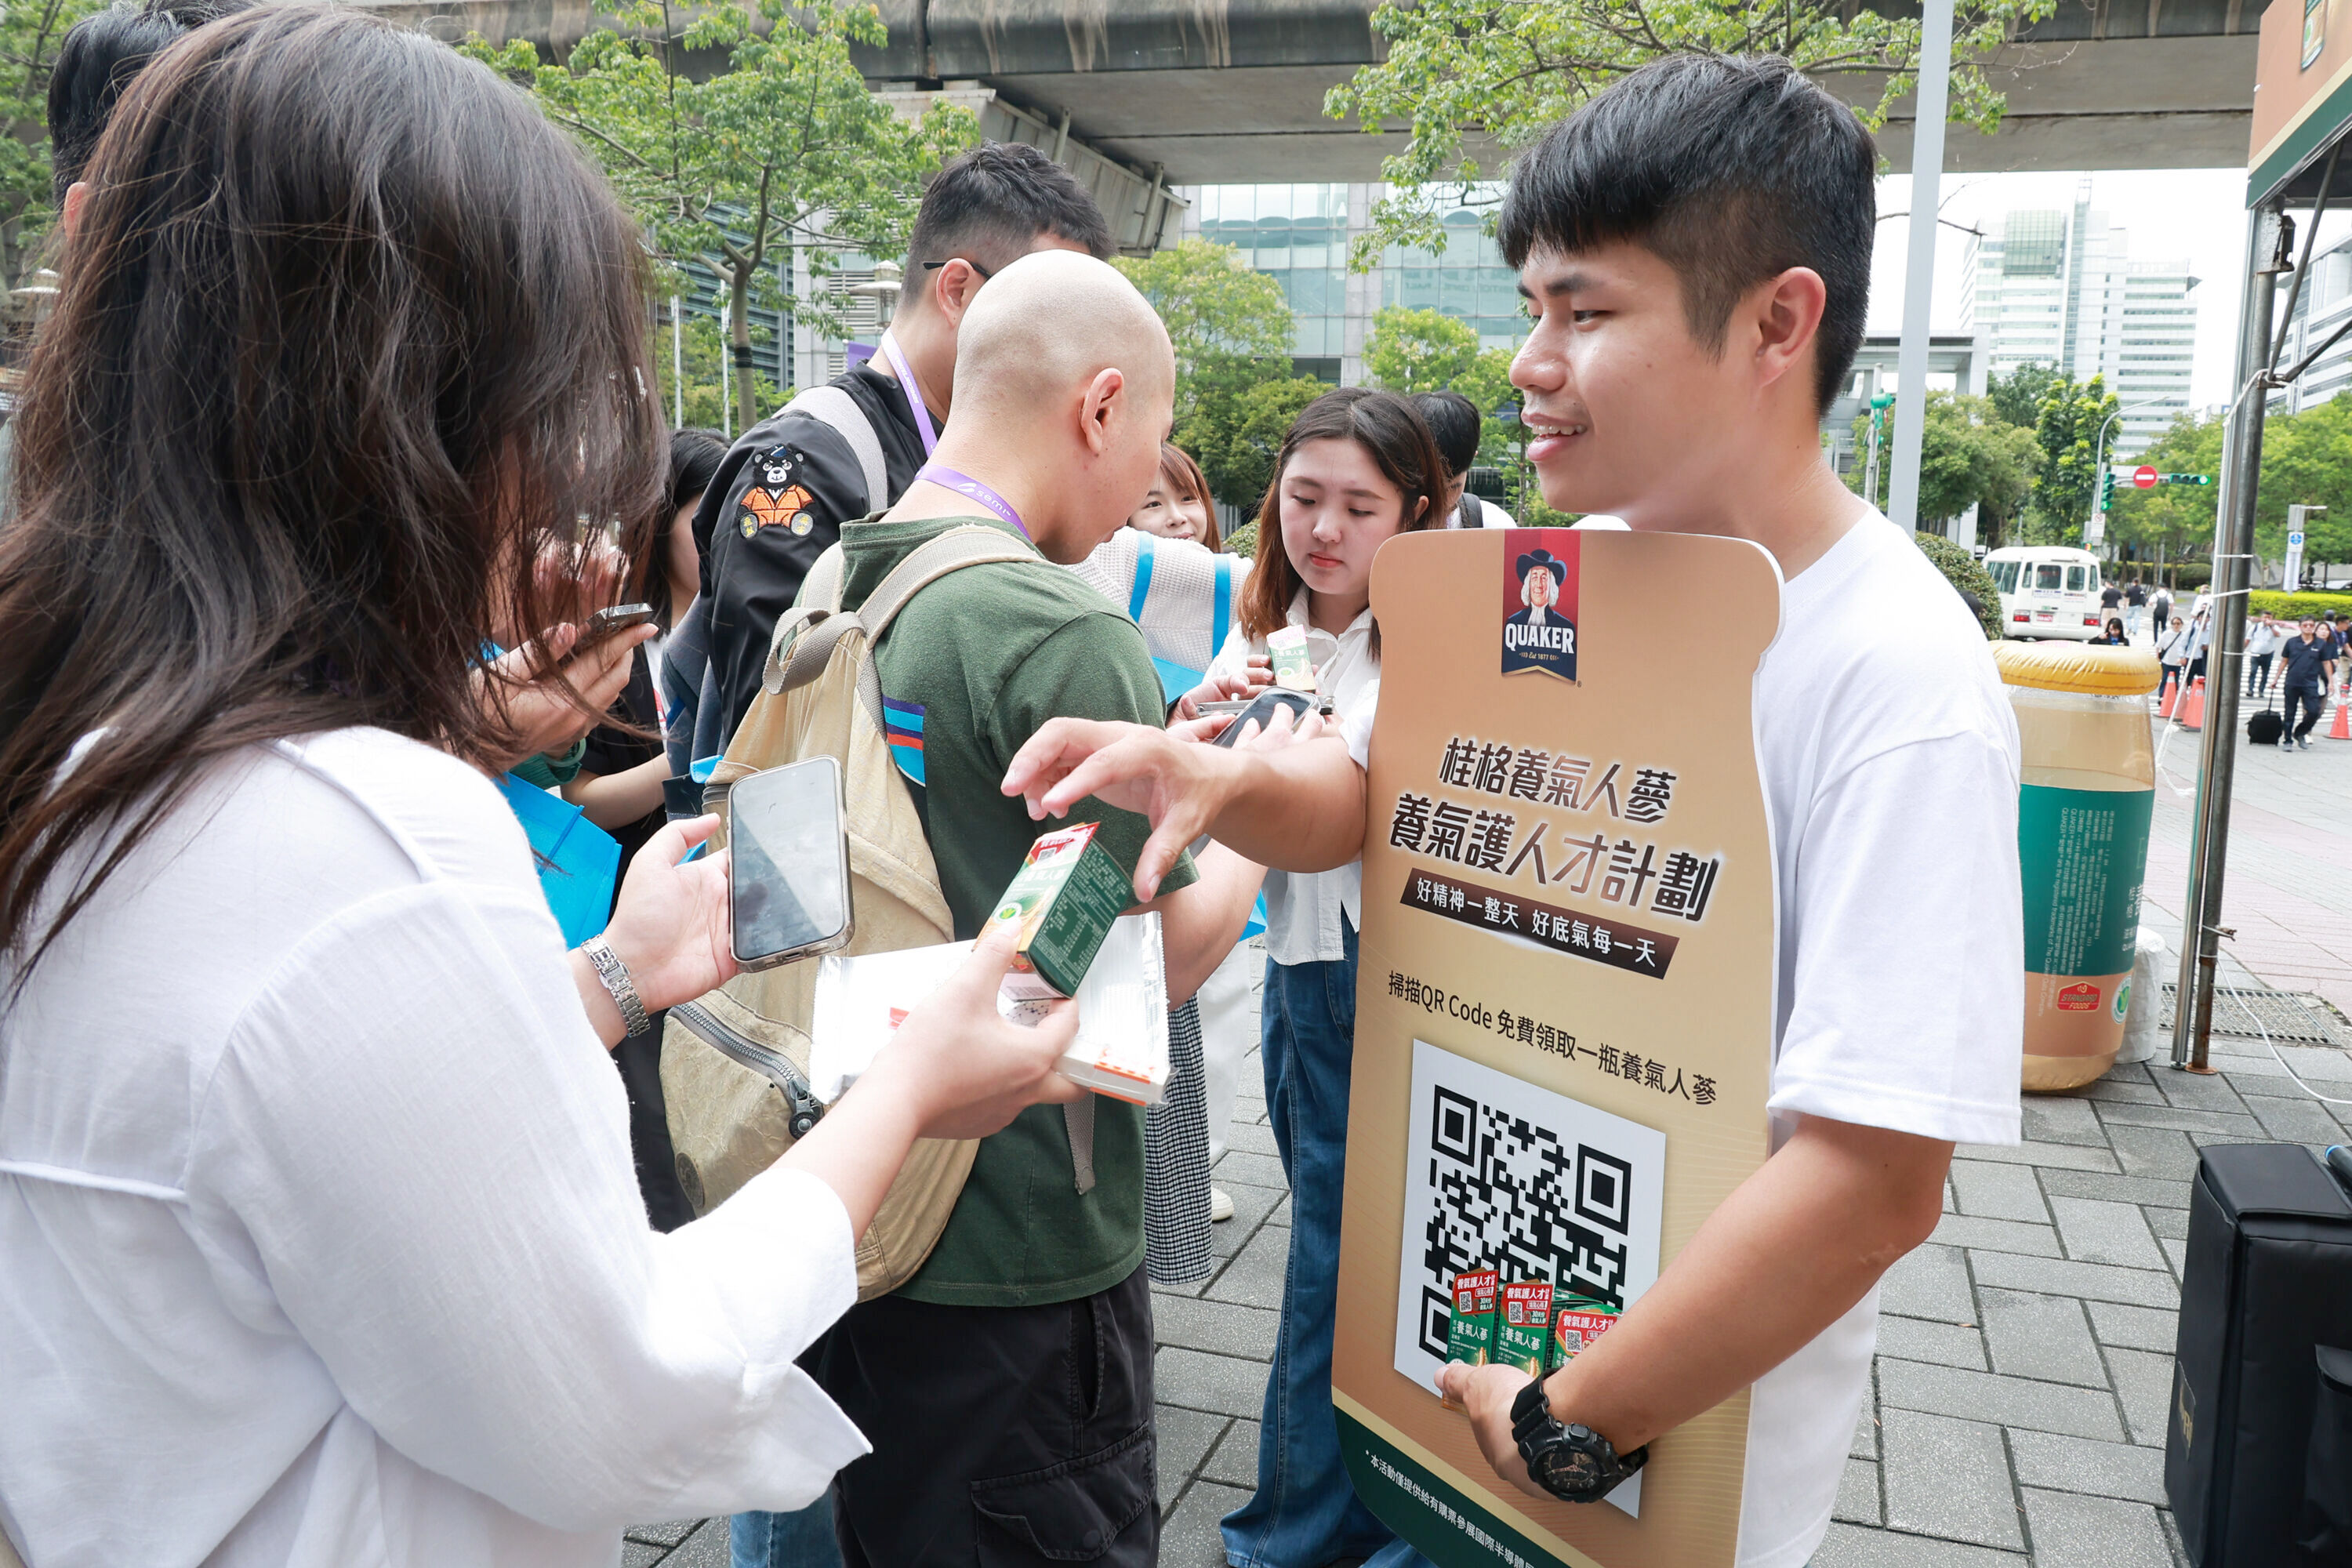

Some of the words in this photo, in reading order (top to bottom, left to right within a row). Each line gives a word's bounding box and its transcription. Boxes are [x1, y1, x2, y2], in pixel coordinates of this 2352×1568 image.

[1505, 623, 1574, 654] QUAKER
[1439, 737, 1676, 823] 桂格養氣人蔘
[1390, 793, 1719, 922] 養氣護人才計劃
[1417, 877, 1519, 929] 好精神一整天
[1532, 909, 1657, 968] 好底氣每一天
[1388, 971, 1445, 1013] 掃描QR
[1449, 995, 1493, 1029] Code
[1497, 1009, 1717, 1105] 免費領取一瓶養氣人蔘
[1457, 1320, 1488, 1341] 養氣人蔘
[1505, 1327, 1541, 1350] 養氣人蔘
